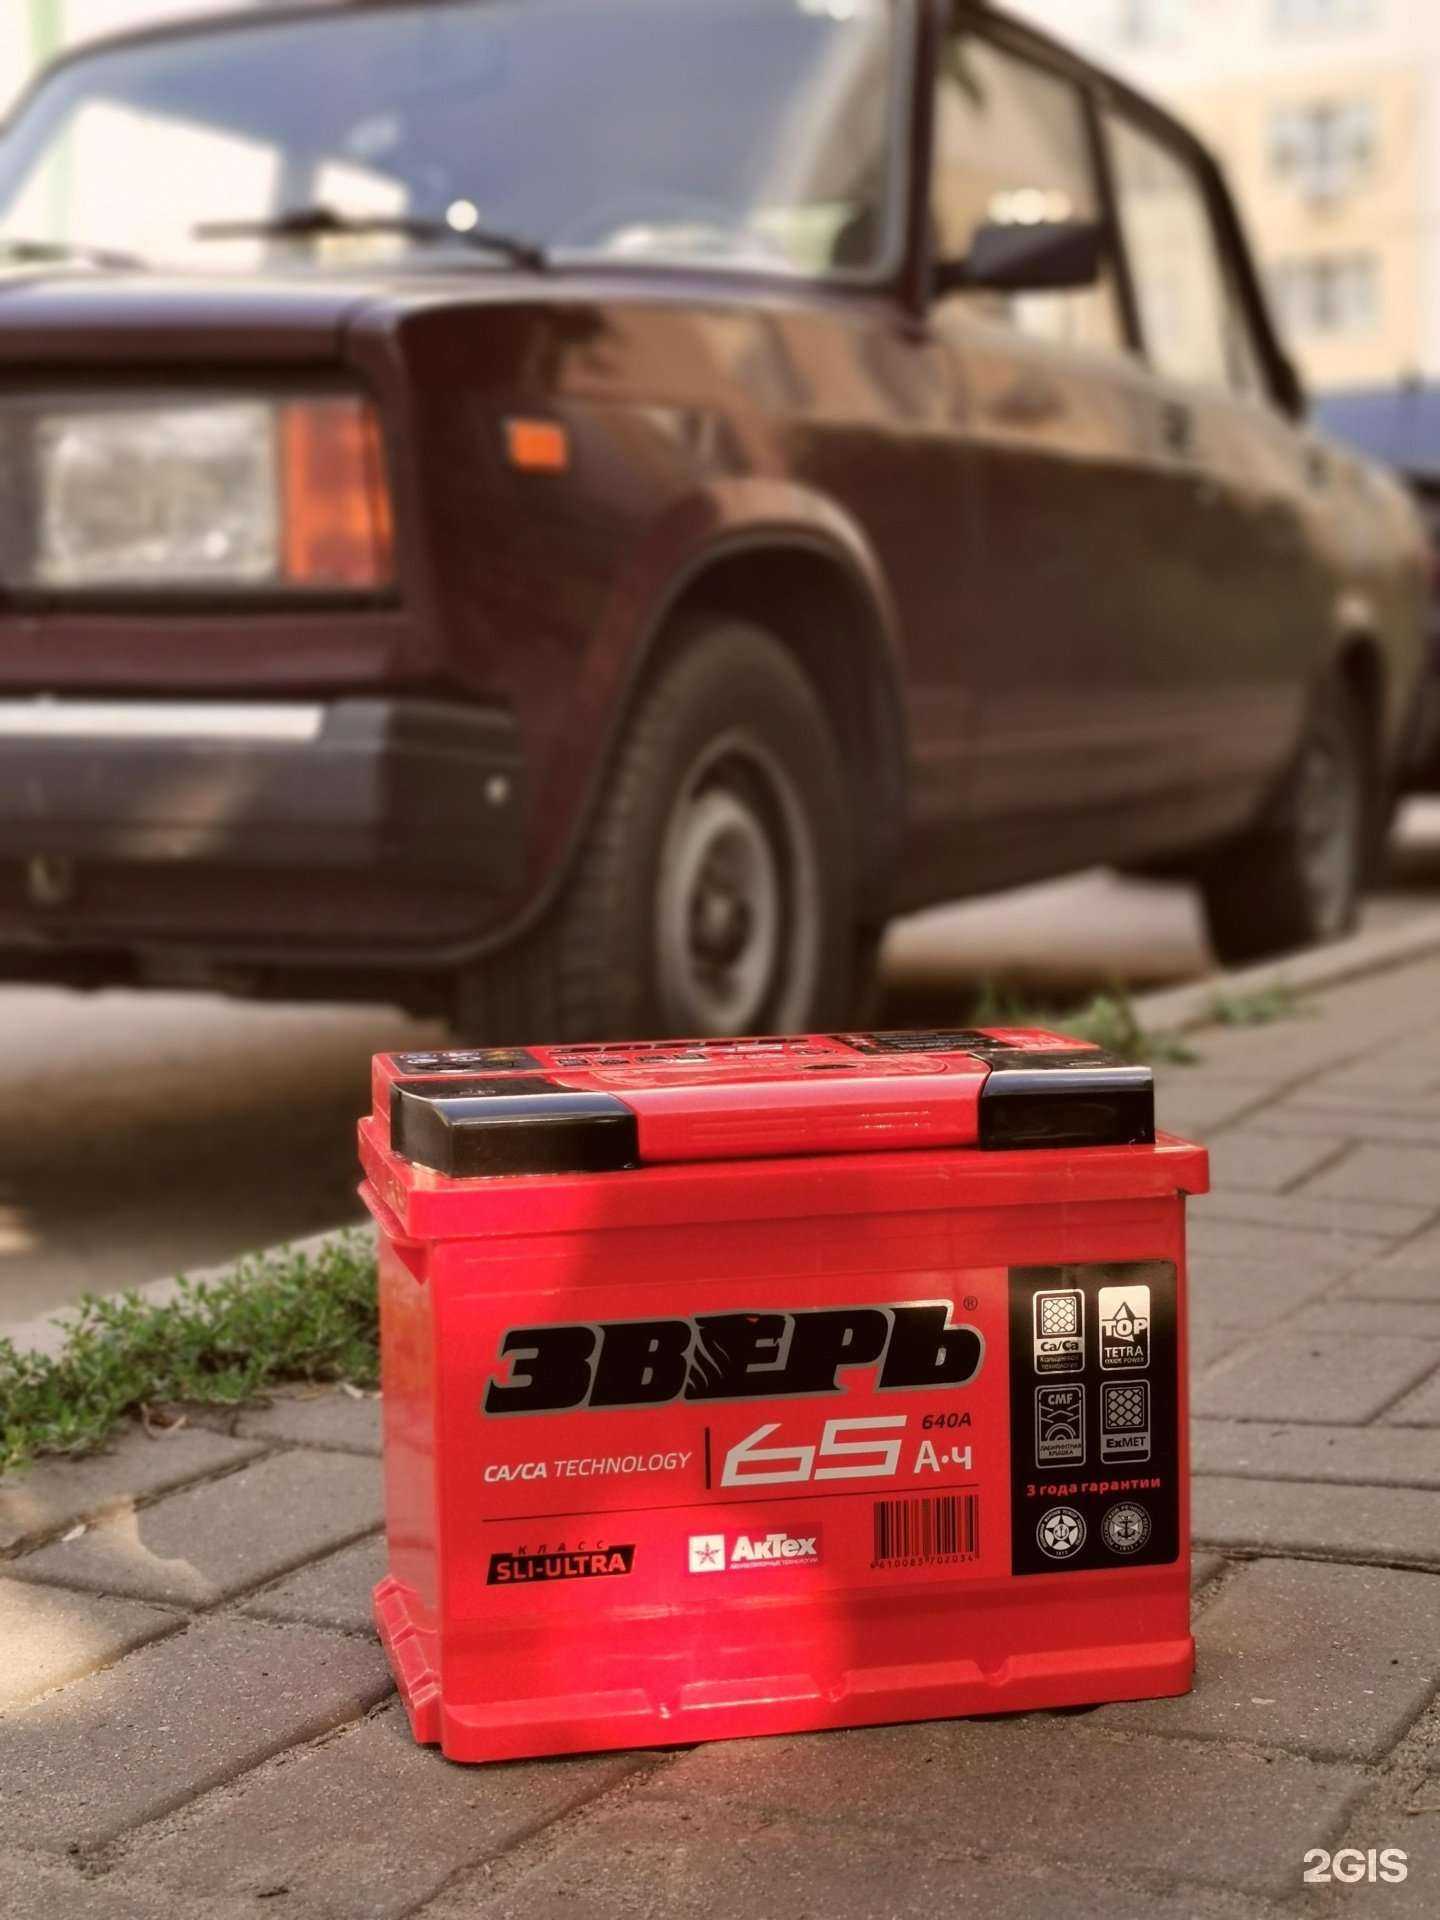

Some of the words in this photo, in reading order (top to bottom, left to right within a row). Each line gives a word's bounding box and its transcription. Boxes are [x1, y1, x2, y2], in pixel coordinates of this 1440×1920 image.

[1101, 1319, 1149, 1338] TOP
[1040, 1340, 1079, 1352] Ca/Ca
[1104, 1345, 1144, 1358] TETRA
[480, 1299, 986, 1418] ЗВЕРЬ
[1048, 1393, 1073, 1405] CMF
[1106, 1436, 1146, 1448] ExMET
[720, 1415, 908, 1488] 65
[483, 1463, 547, 1483] CA/CA
[553, 1452, 693, 1477] TECHNOLOGY
[1026, 1484, 1036, 1496] 3
[1040, 1484, 1078, 1496] года
[1081, 1478, 1161, 1494] гарантии
[518, 1540, 604, 1555] КЛАСС
[496, 1553, 627, 1580] SLI-ULTRA
